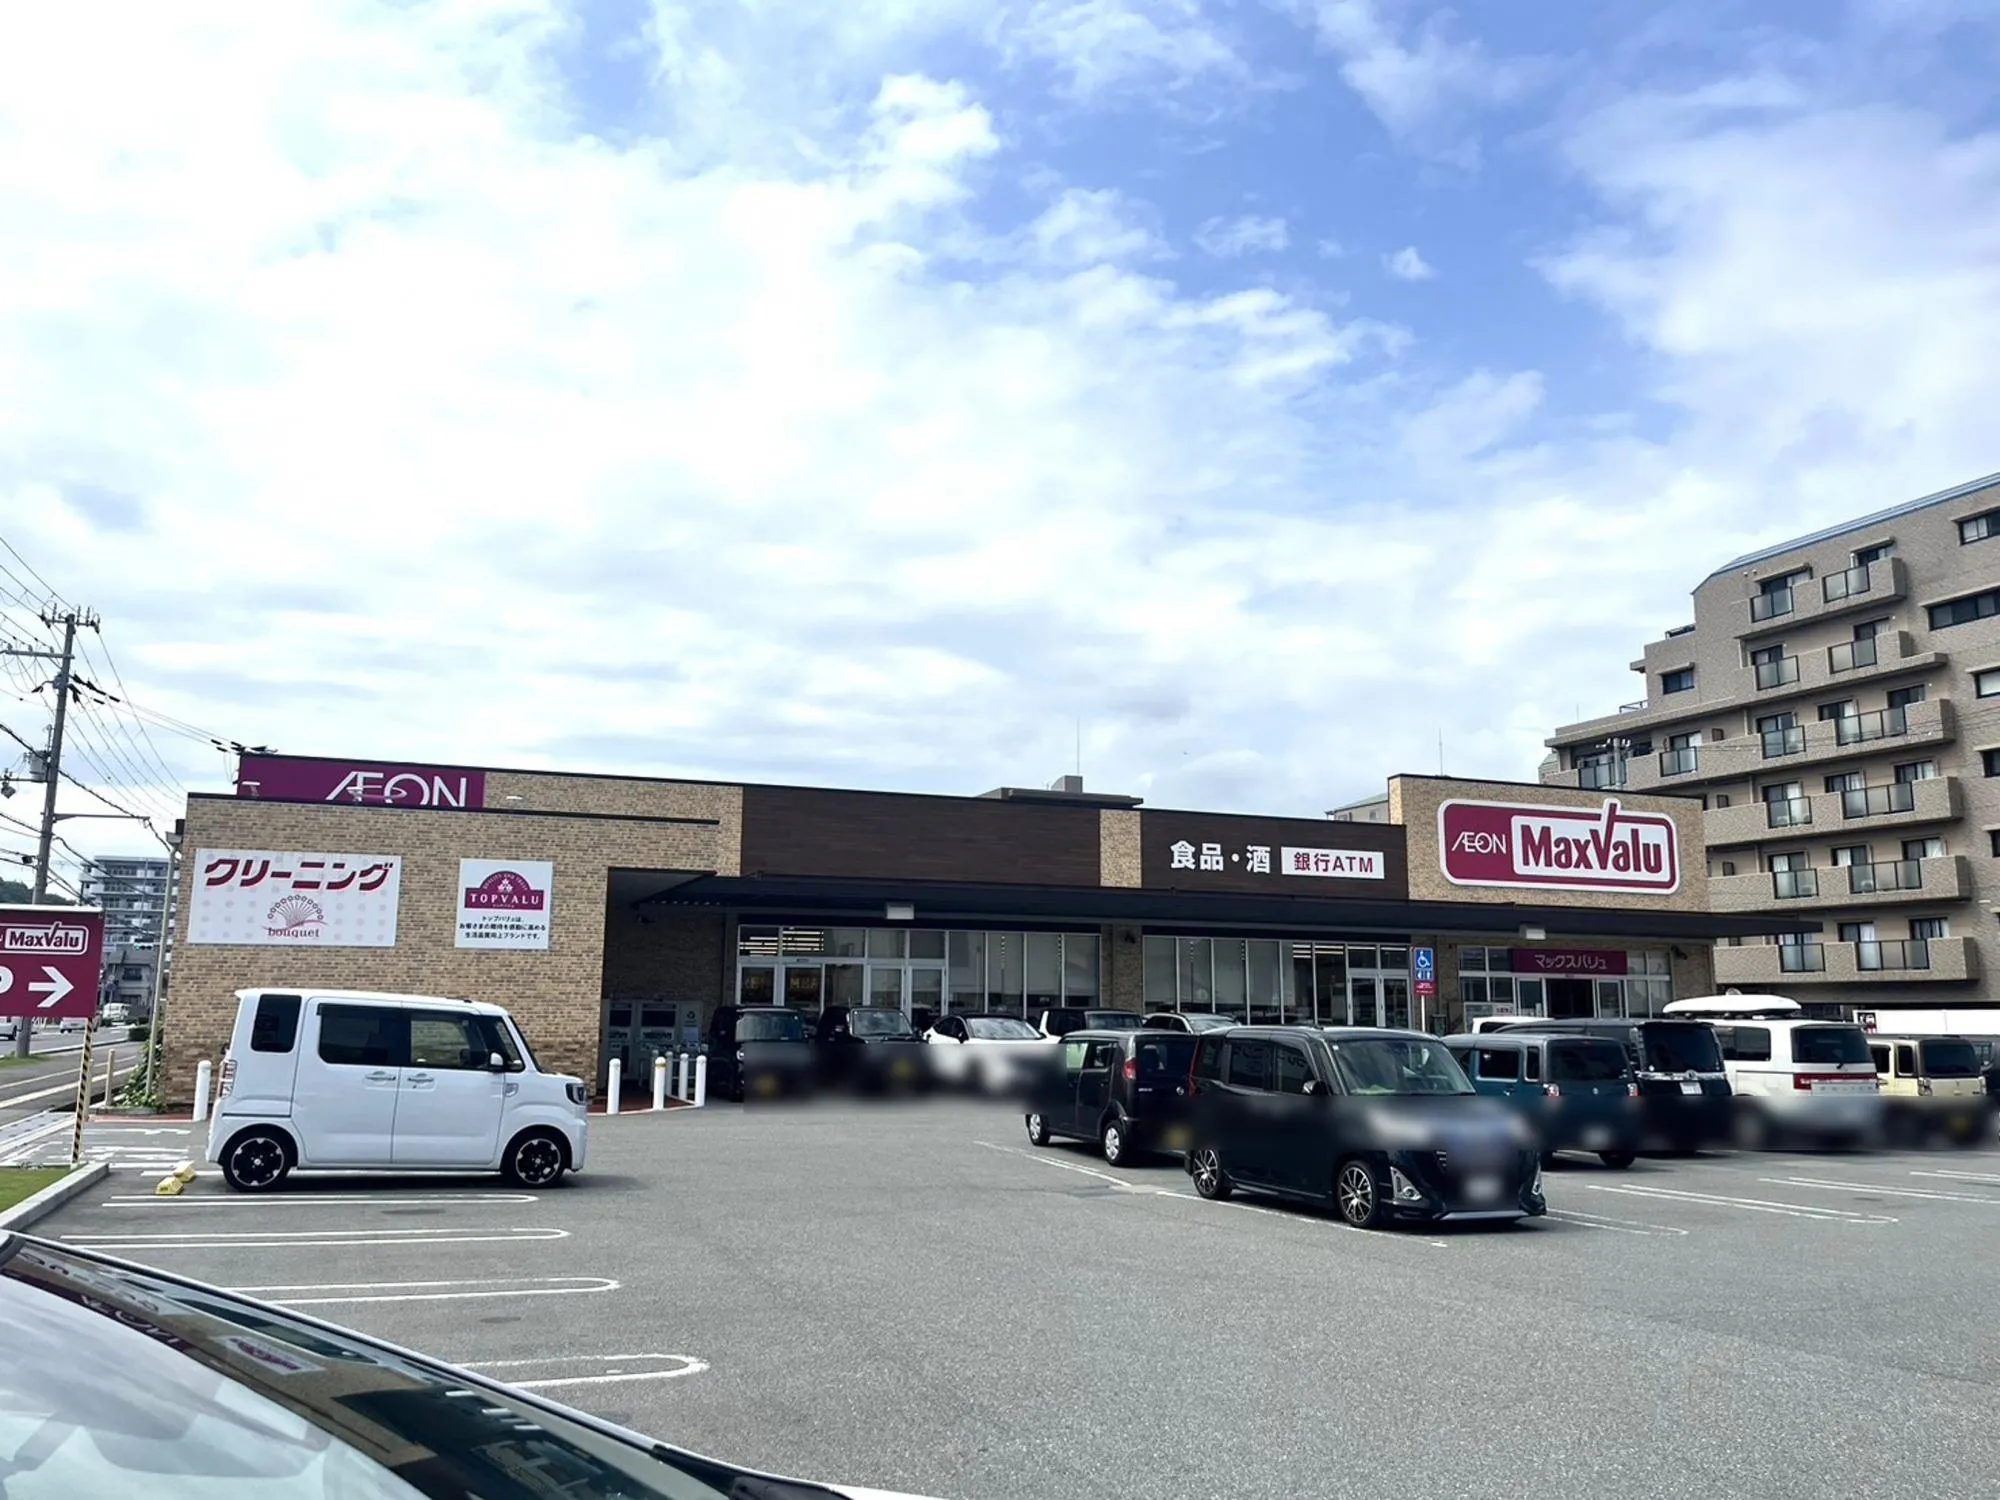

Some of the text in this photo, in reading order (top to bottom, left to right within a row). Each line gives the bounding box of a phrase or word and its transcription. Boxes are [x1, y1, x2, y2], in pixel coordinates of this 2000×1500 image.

[1520, 803, 1662, 874] MaxValu
[1170, 840, 1271, 874] 食品・酒
[1293, 852, 1373, 873] 銀行ATM
[204, 858, 394, 891] クリーニング
[470, 894, 539, 904] TOPVALU
[9, 922, 79, 948] MaxValu
[267, 927, 320, 938] bouquet
[1534, 954, 1608, 970] マックスバリュ
